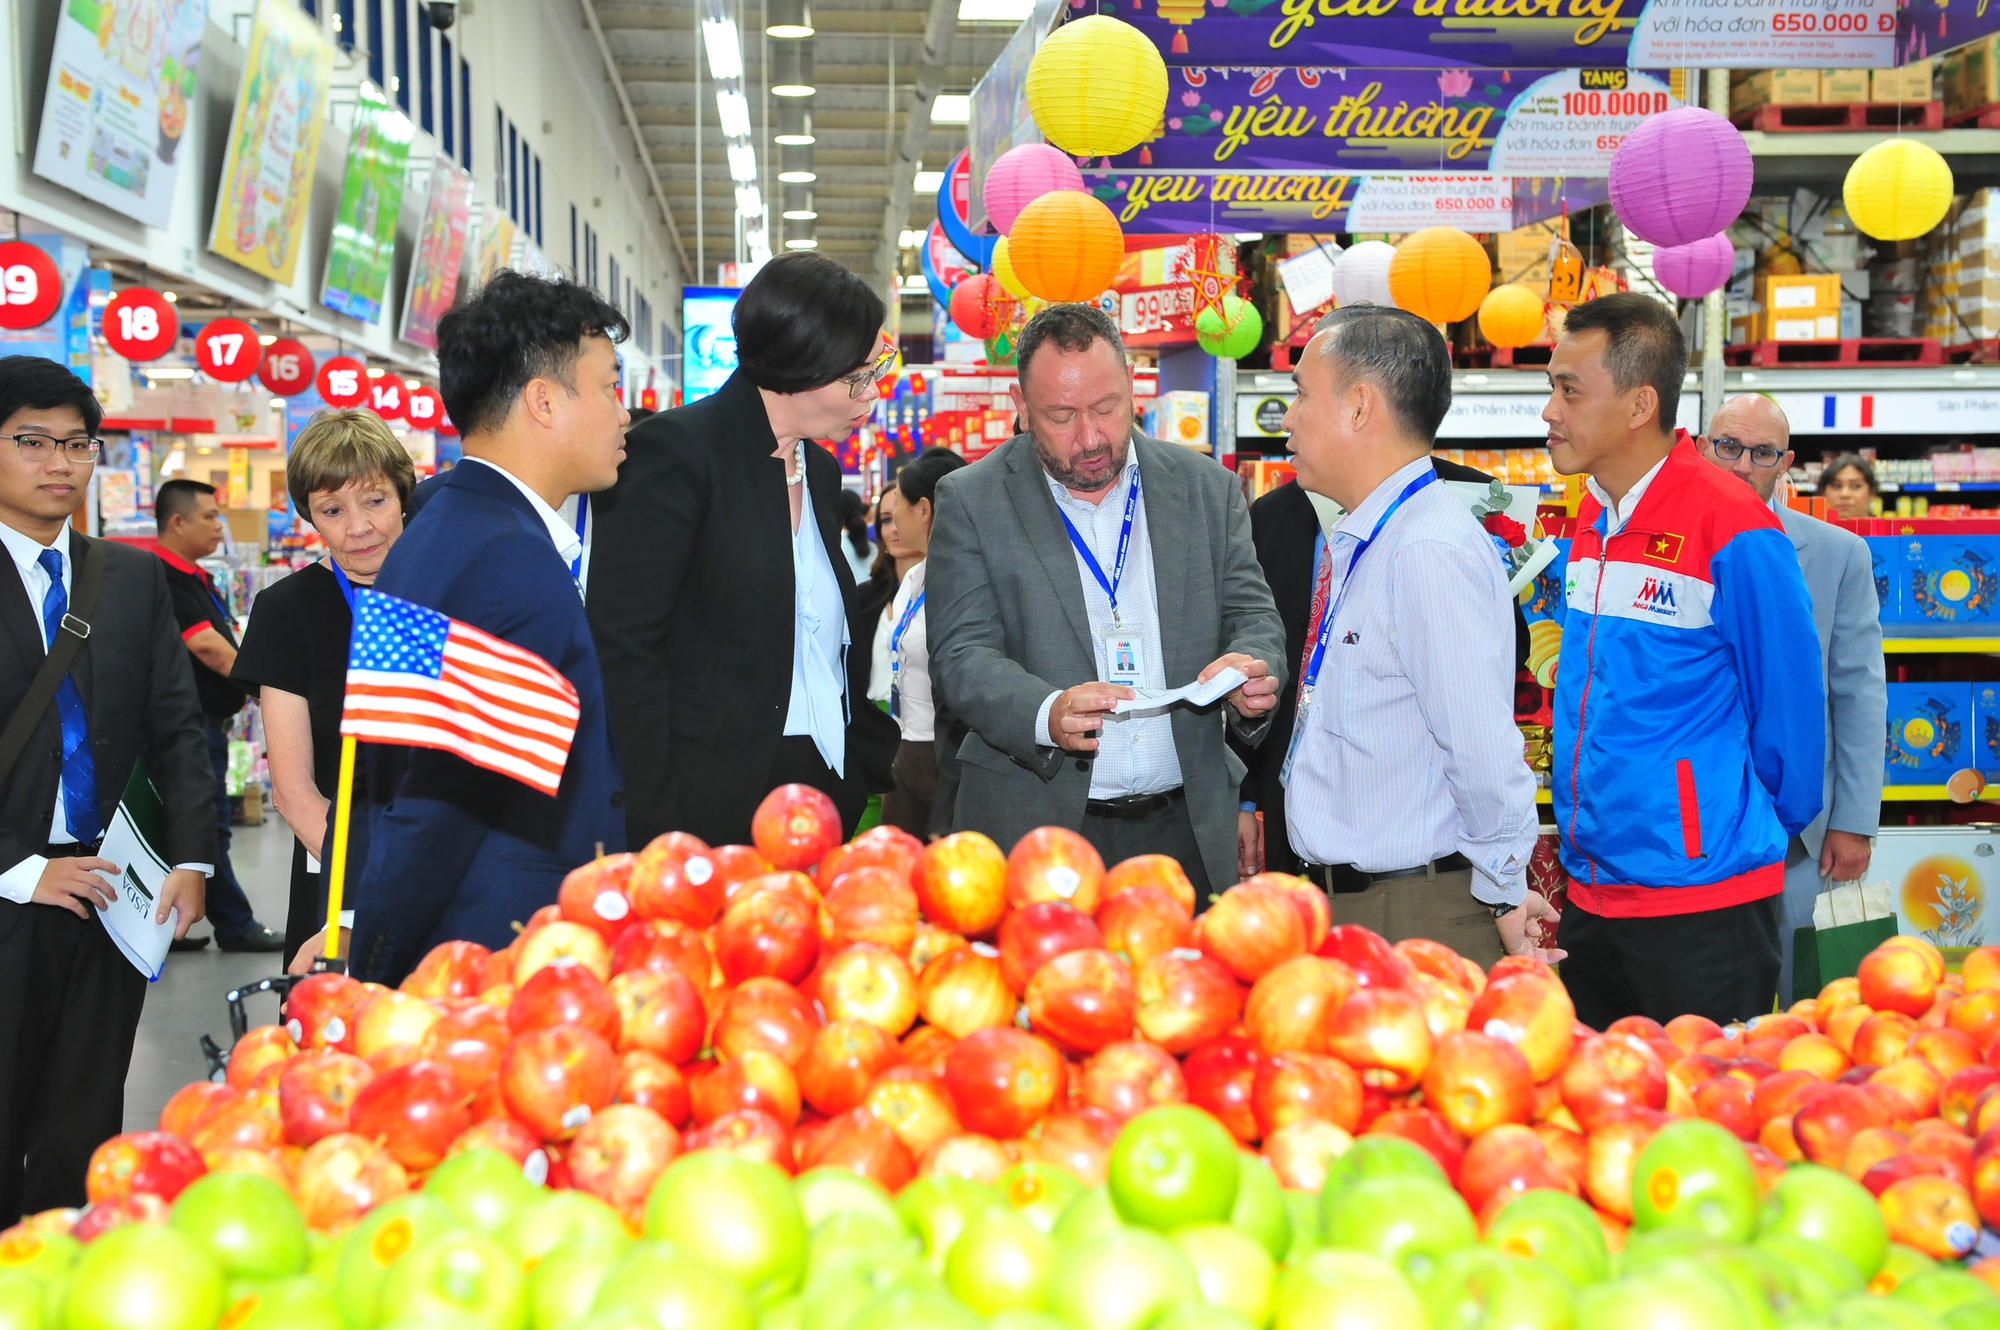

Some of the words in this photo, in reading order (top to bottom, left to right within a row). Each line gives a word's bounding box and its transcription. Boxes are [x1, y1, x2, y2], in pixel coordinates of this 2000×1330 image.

[1653, 15, 1681, 32] với
[1685, 15, 1723, 32] hóa
[1728, 17, 1766, 32] đơn
[1772, 13, 1868, 32] 650.000
[1877, 13, 1895, 32] Đ
[1213, 93, 1317, 161] yêu
[1323, 81, 1495, 160] thương
[1506, 119, 1528, 131] Khi
[1530, 121, 1563, 131] mua
[1567, 119, 1605, 131] bánh
[1608, 119, 1641, 132] trun
[1506, 136, 1527, 150] với
[1530, 136, 1559, 150] hóa
[1563, 137, 1592, 150] đơn
[117, 305, 159, 341] 18
[1135, 295, 1159, 326] 99
[206, 333, 244, 367] 17
[268, 353, 300, 382] 16
[327, 369, 359, 396] 15
[371, 385, 400, 410] 14
[409, 394, 435, 418] 13
[122, 874, 149, 920] USDA
